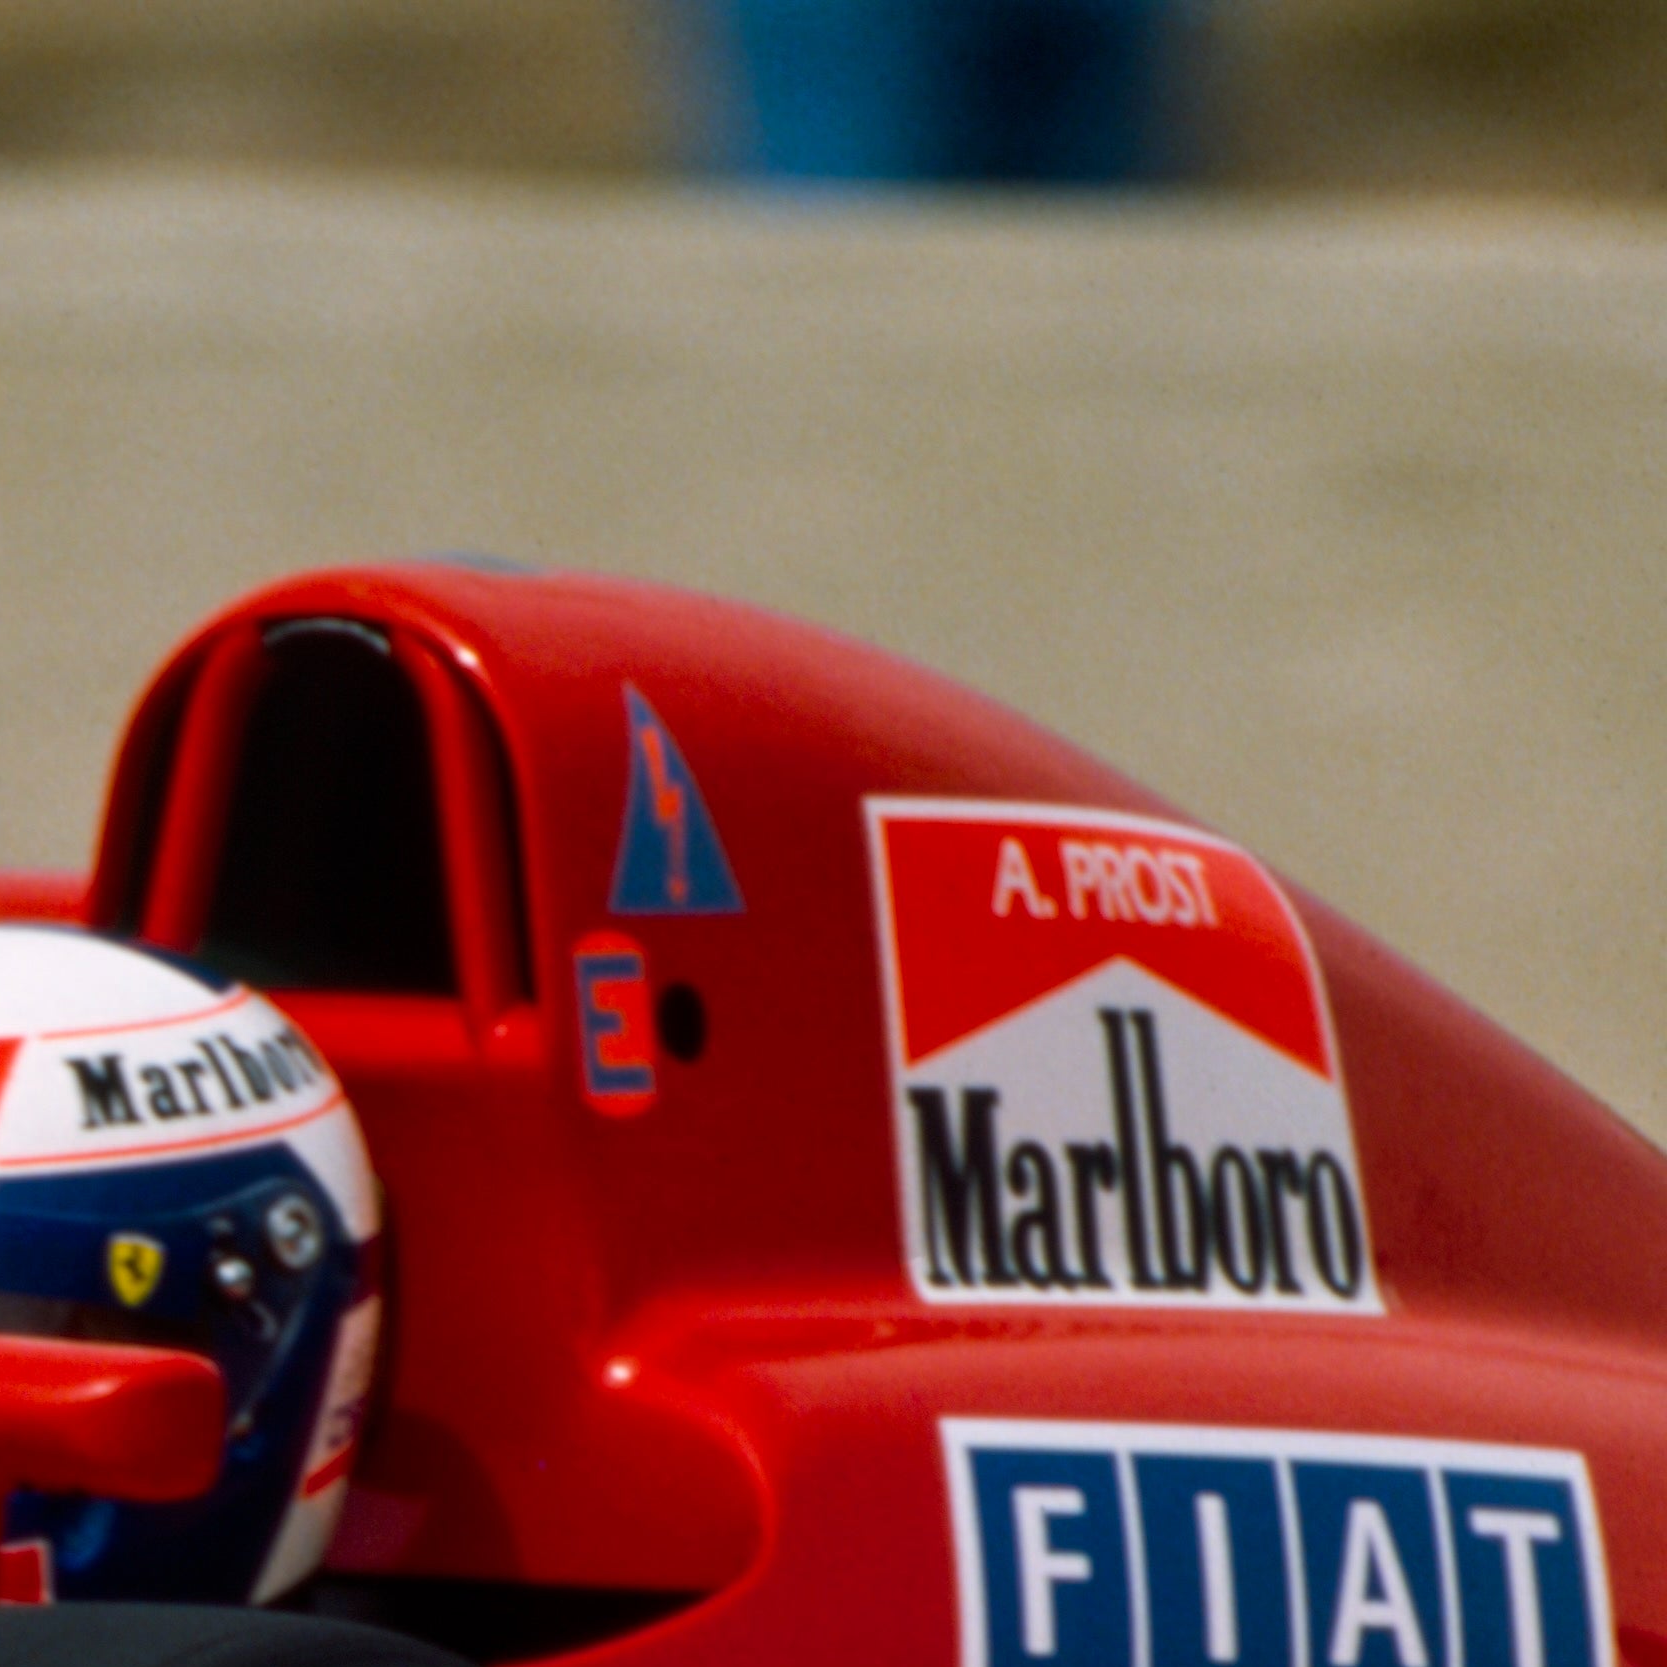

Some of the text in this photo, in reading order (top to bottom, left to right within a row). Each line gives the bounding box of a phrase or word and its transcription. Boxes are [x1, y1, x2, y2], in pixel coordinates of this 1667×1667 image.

[989, 834, 1221, 929] A. PROST
[572, 952, 659, 1097] E
[905, 1003, 1366, 1300] Marlboro
